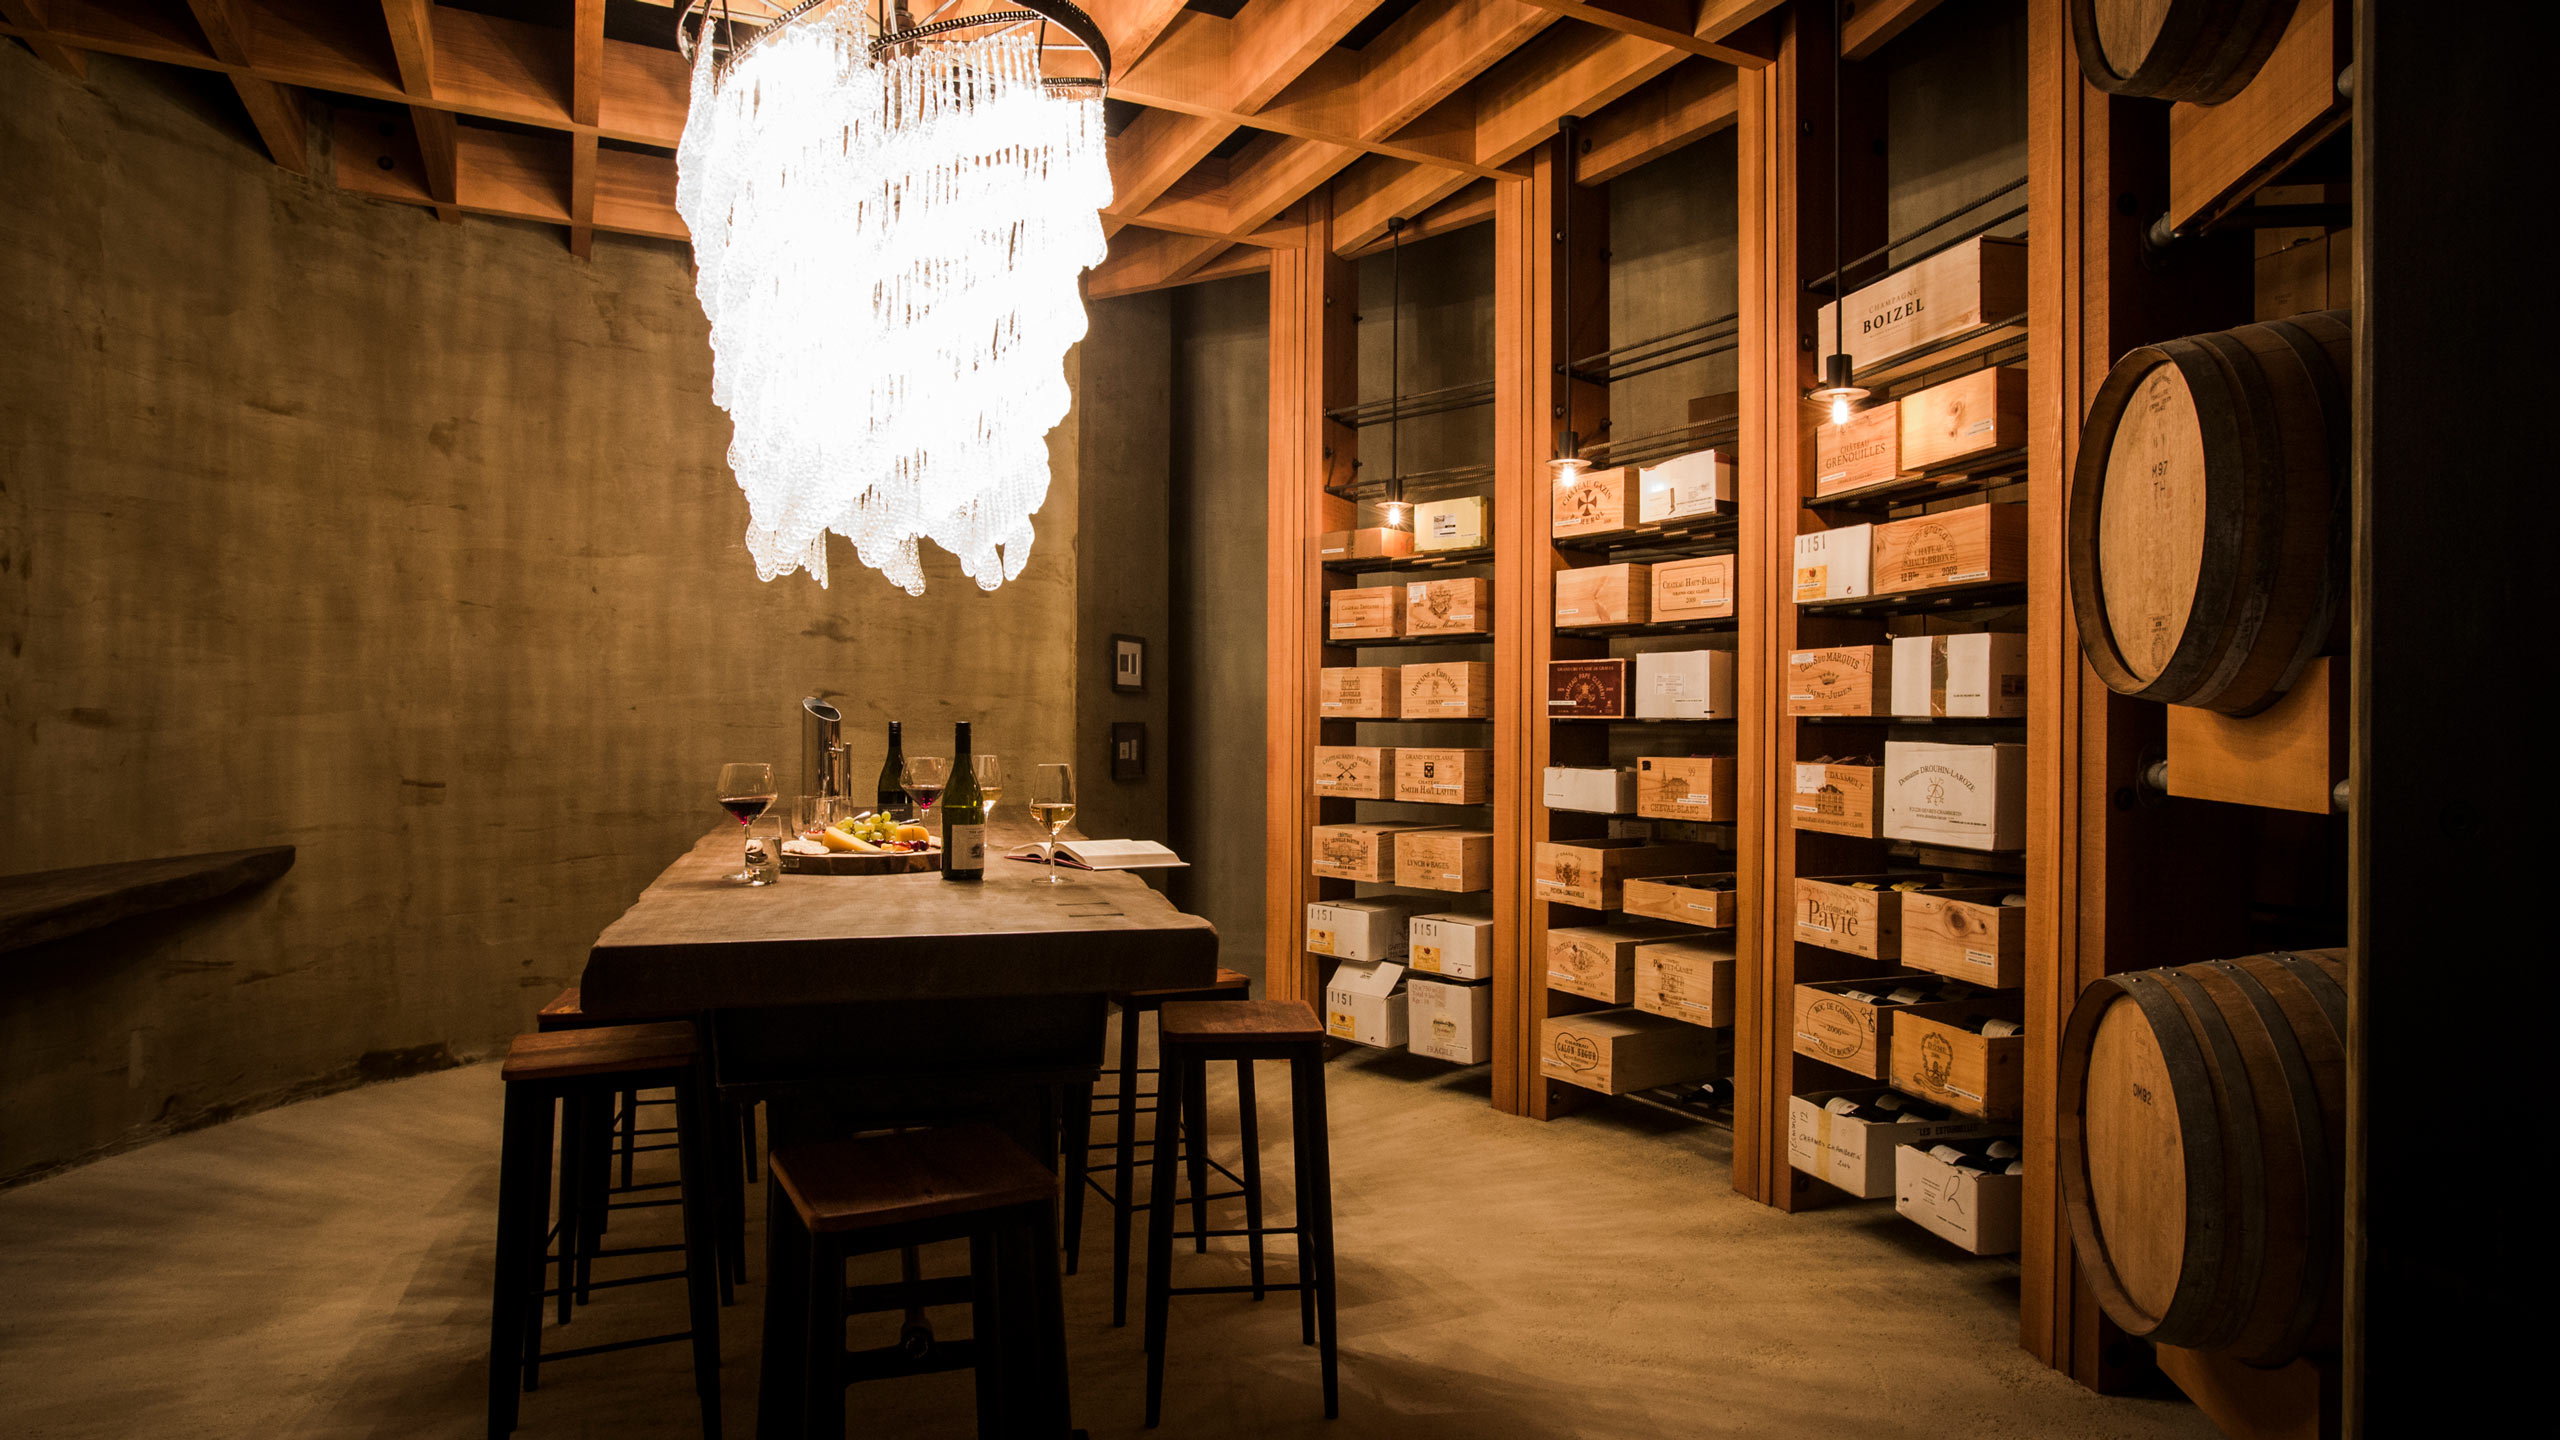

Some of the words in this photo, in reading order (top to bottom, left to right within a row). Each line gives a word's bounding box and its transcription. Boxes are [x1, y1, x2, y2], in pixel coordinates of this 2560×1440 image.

[1868, 288, 1919, 314] CHAMPAGNE
[1862, 297, 1926, 335] BOIZEL
[1825, 442, 1886, 470] GRENOUILLES
[1800, 533, 1826, 555] 1151
[1941, 565, 1958, 577] 2002
[1826, 652, 1860, 670] MARQUIS
[1688, 766, 1696, 777] 99
[1920, 765, 1976, 793] DROUHIN-LAROZE
[1650, 803, 1699, 815] CHEVAL-BLANC
[1407, 859, 1425, 867] LYNCH
[1431, 861, 1449, 870] BAGES
[1310, 908, 1333, 922] 1151
[1808, 898, 1859, 937] Pavie
[1414, 922, 1438, 937] 1151
[1330, 990, 1353, 1006] 1151
[1426, 1045, 1454, 1057] FRAGILE
